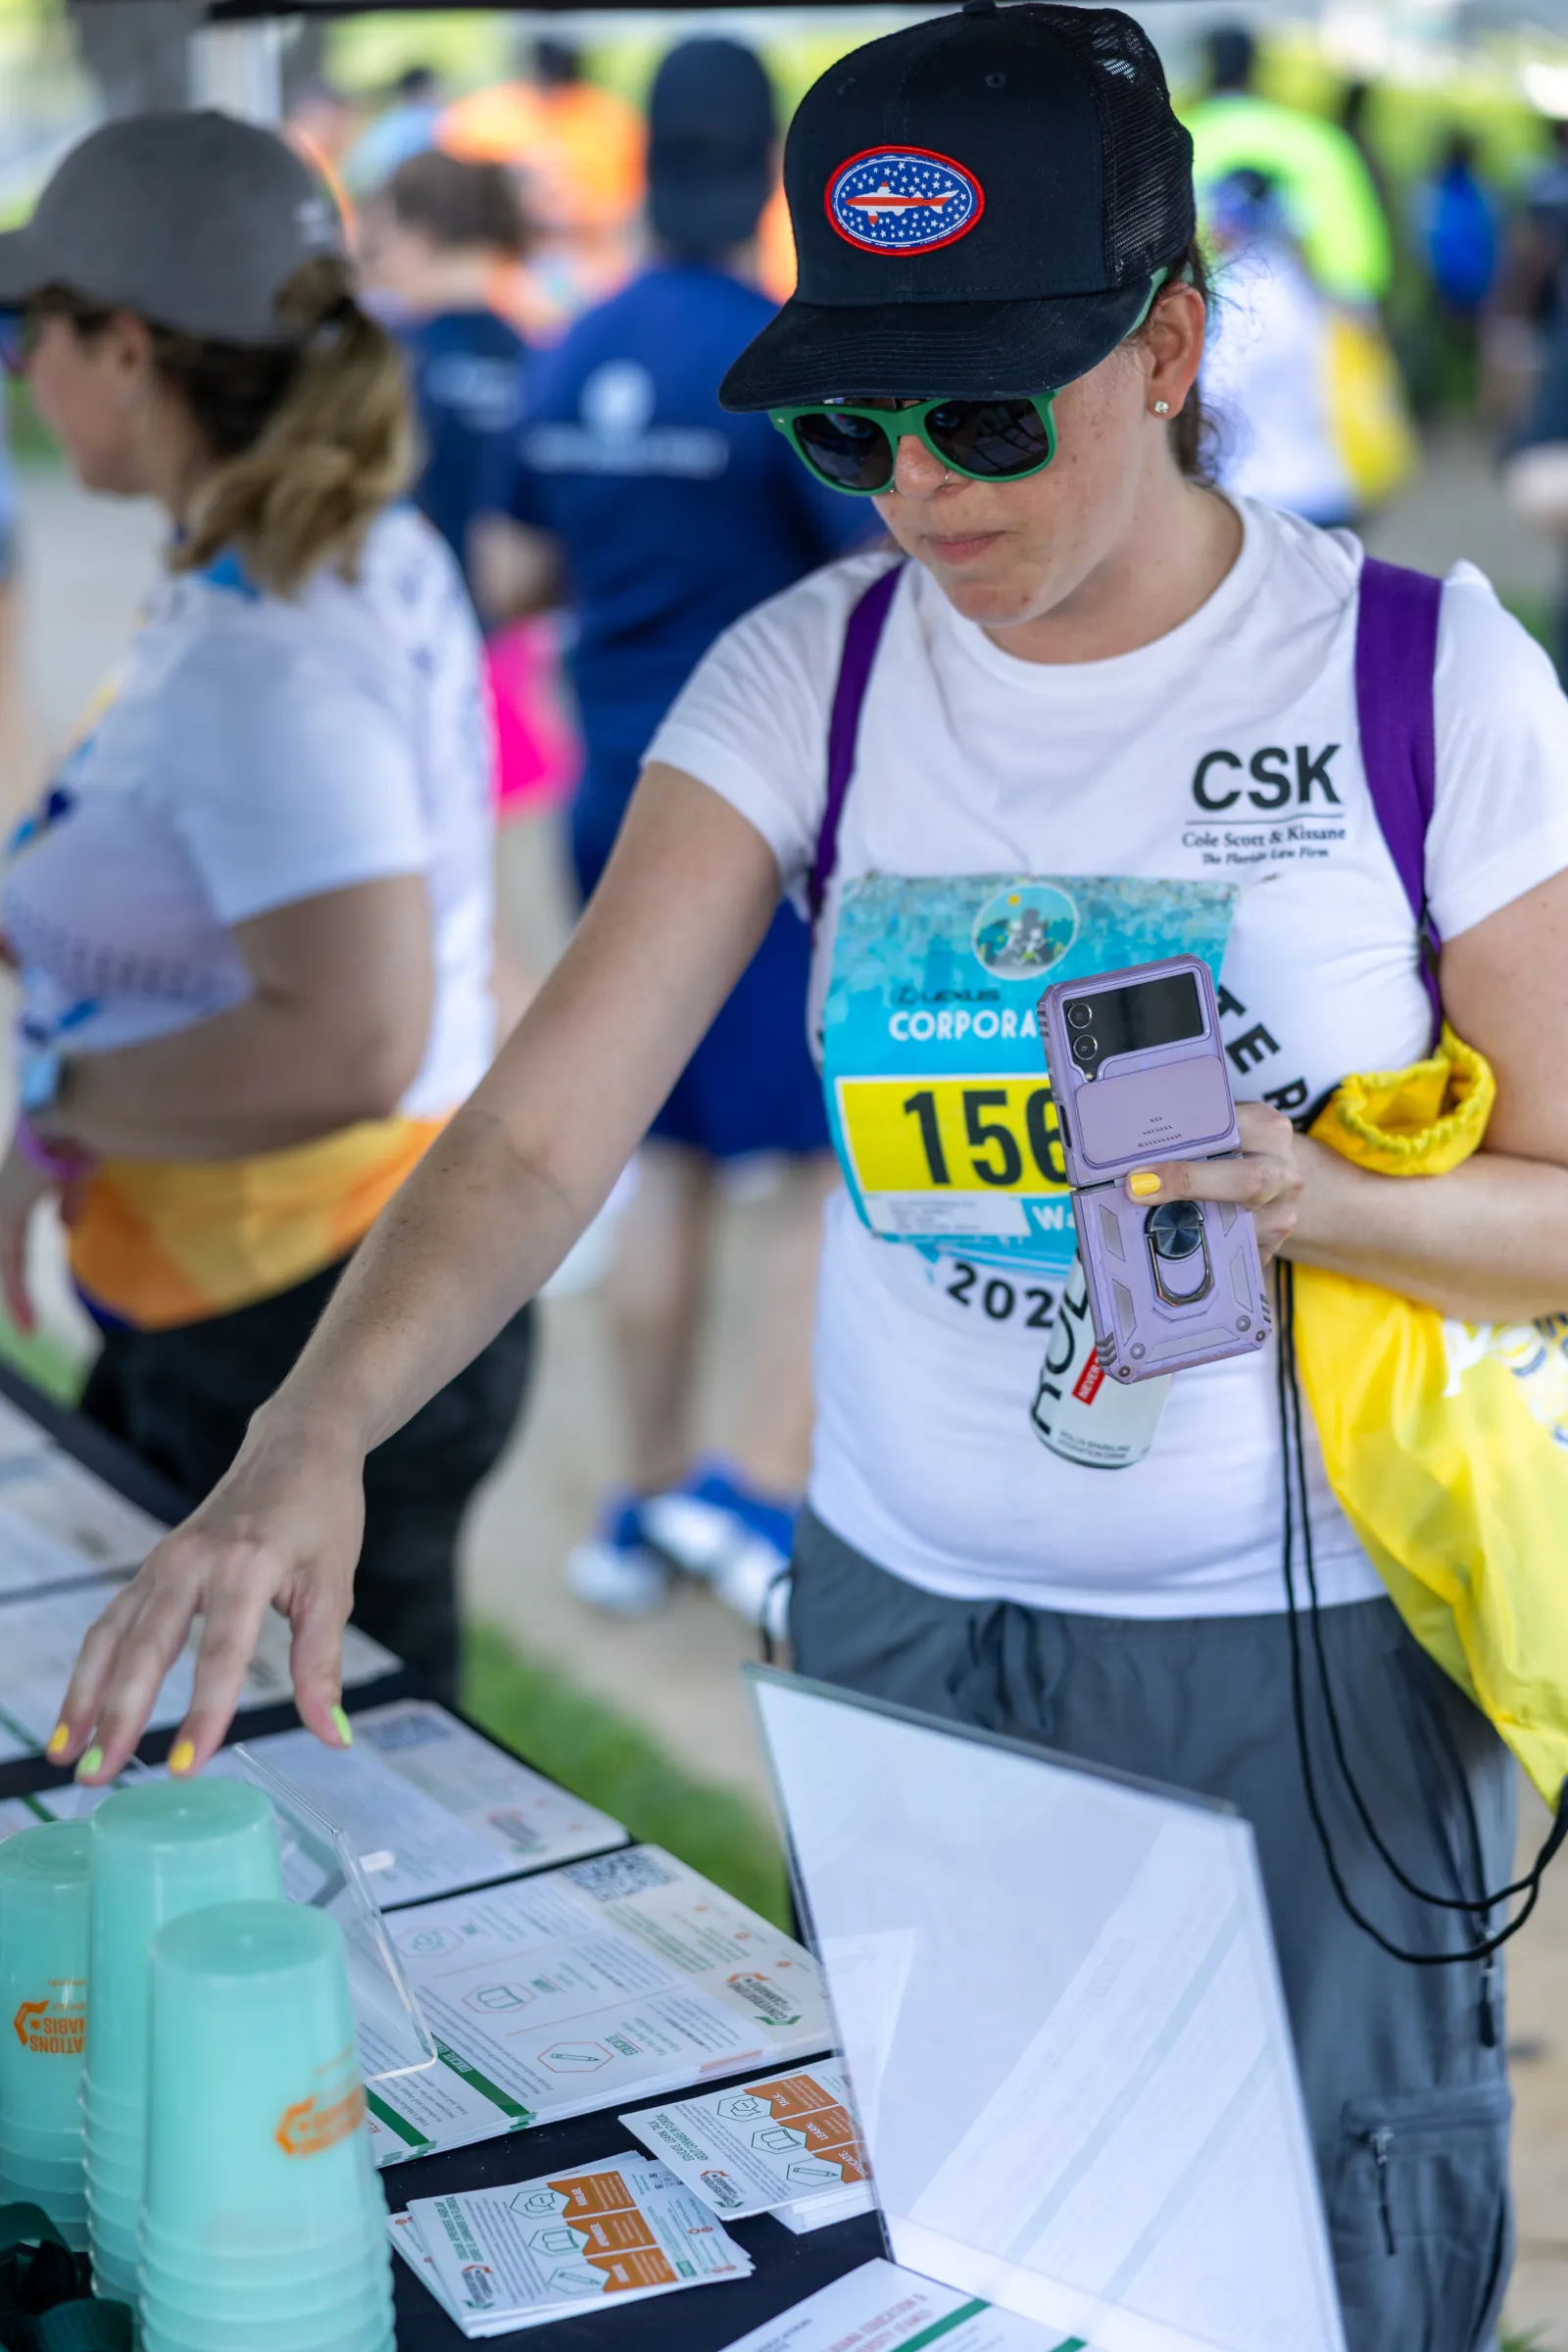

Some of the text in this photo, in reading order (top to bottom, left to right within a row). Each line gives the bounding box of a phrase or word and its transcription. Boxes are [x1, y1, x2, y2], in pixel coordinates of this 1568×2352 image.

[1193, 744, 1342, 811] CSK
[1183, 824, 1346, 848] Cole Scott & Kissane
[1202, 845, 1329, 865] The Florida Law Firm
[889, 1009, 1038, 1041] CORPORA
[904, 1088, 1067, 1186] 156
[1076, 1363, 1101, 1399] NEVER
[802, 2121, 829, 2140] LEARN.
